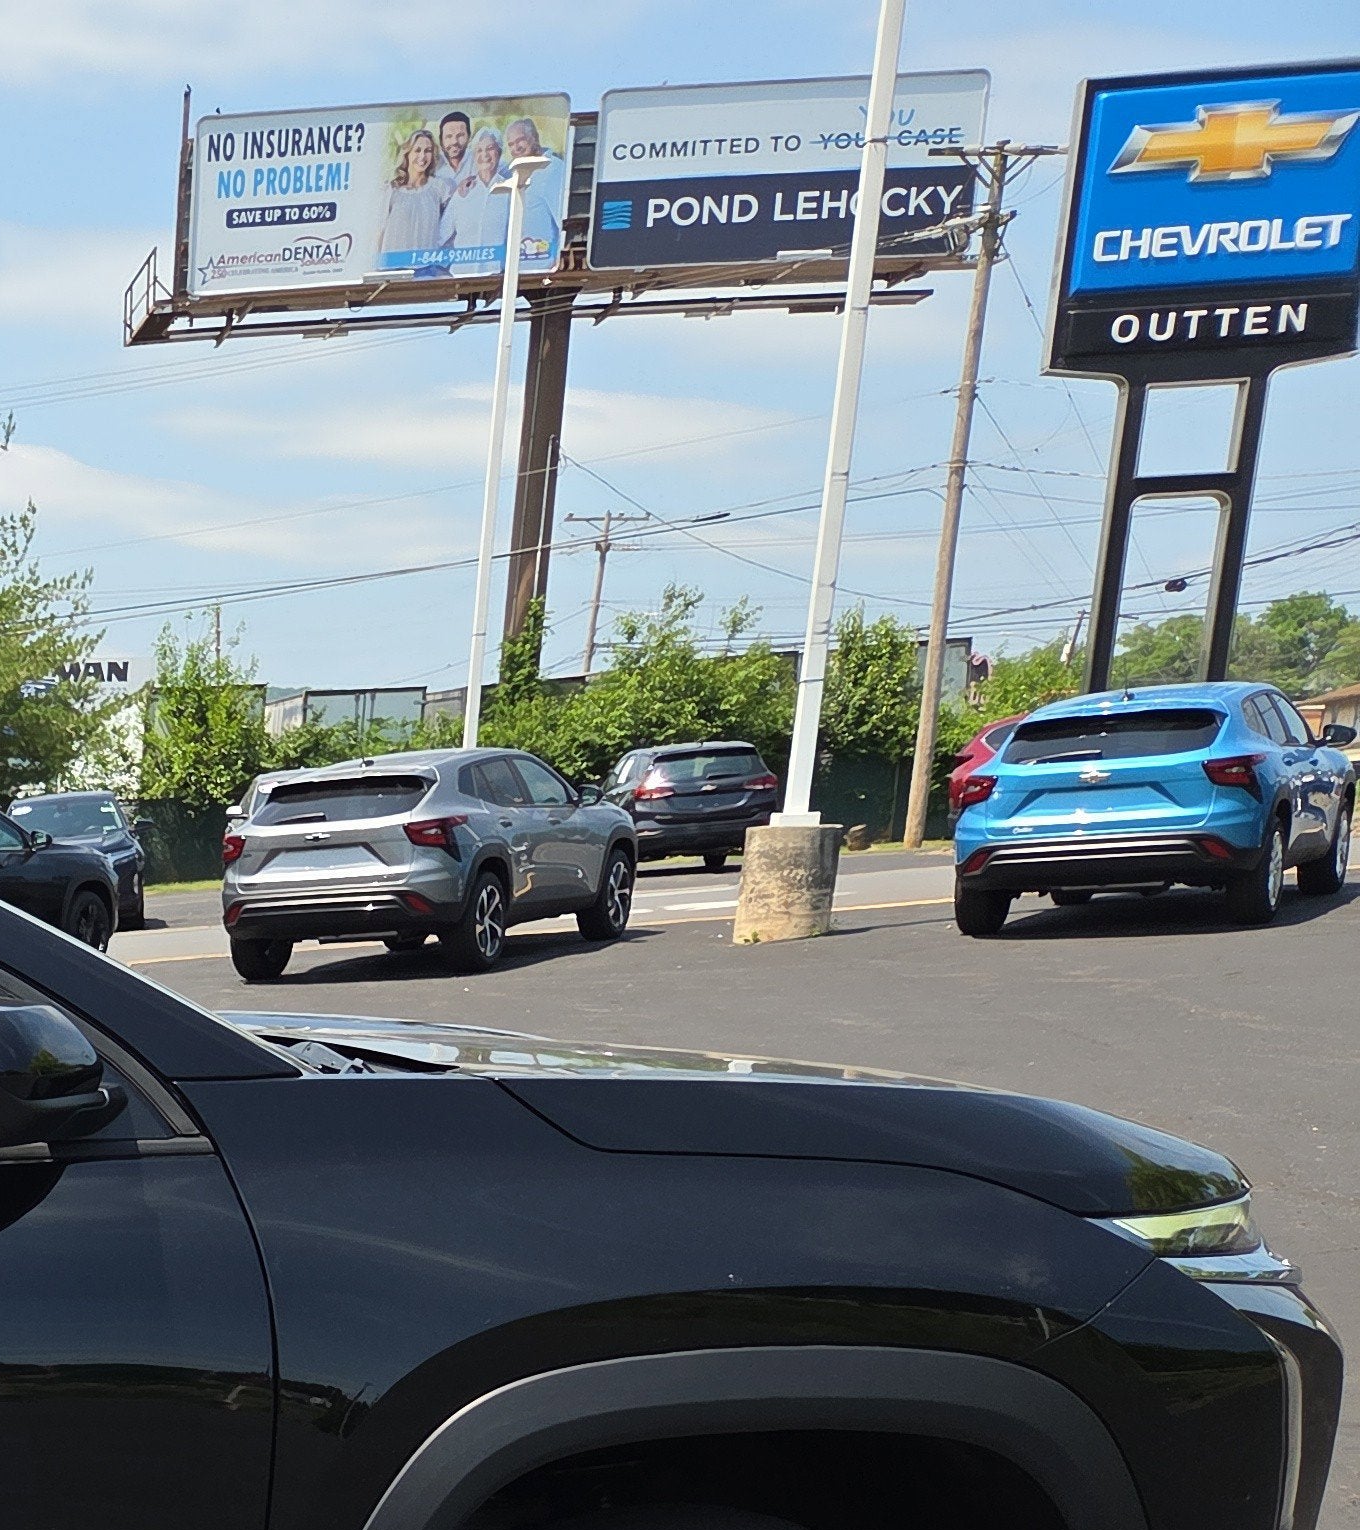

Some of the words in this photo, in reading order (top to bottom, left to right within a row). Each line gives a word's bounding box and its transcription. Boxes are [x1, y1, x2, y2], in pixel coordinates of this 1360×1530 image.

[207, 132, 236, 163] NO
[243, 122, 365, 161] INSURANCE?
[612, 137, 760, 161] COMMITTED
[770, 135, 802, 152] TO
[897, 126, 962, 147] CASE
[217, 168, 246, 199] NO
[253, 161, 350, 197] PROBLEM!
[232, 210, 262, 225] SAVE
[264, 208, 281, 222] UP
[285, 207, 300, 221] TO
[302, 205, 331, 219] 60%
[646, 193, 758, 228] POND
[773, 184, 964, 221] LEHCKY
[410, 247, 496, 265] 1-844-9SMILES
[1092, 213, 1352, 262] CHEVROLET
[1111, 303, 1308, 344] OUTTEN
